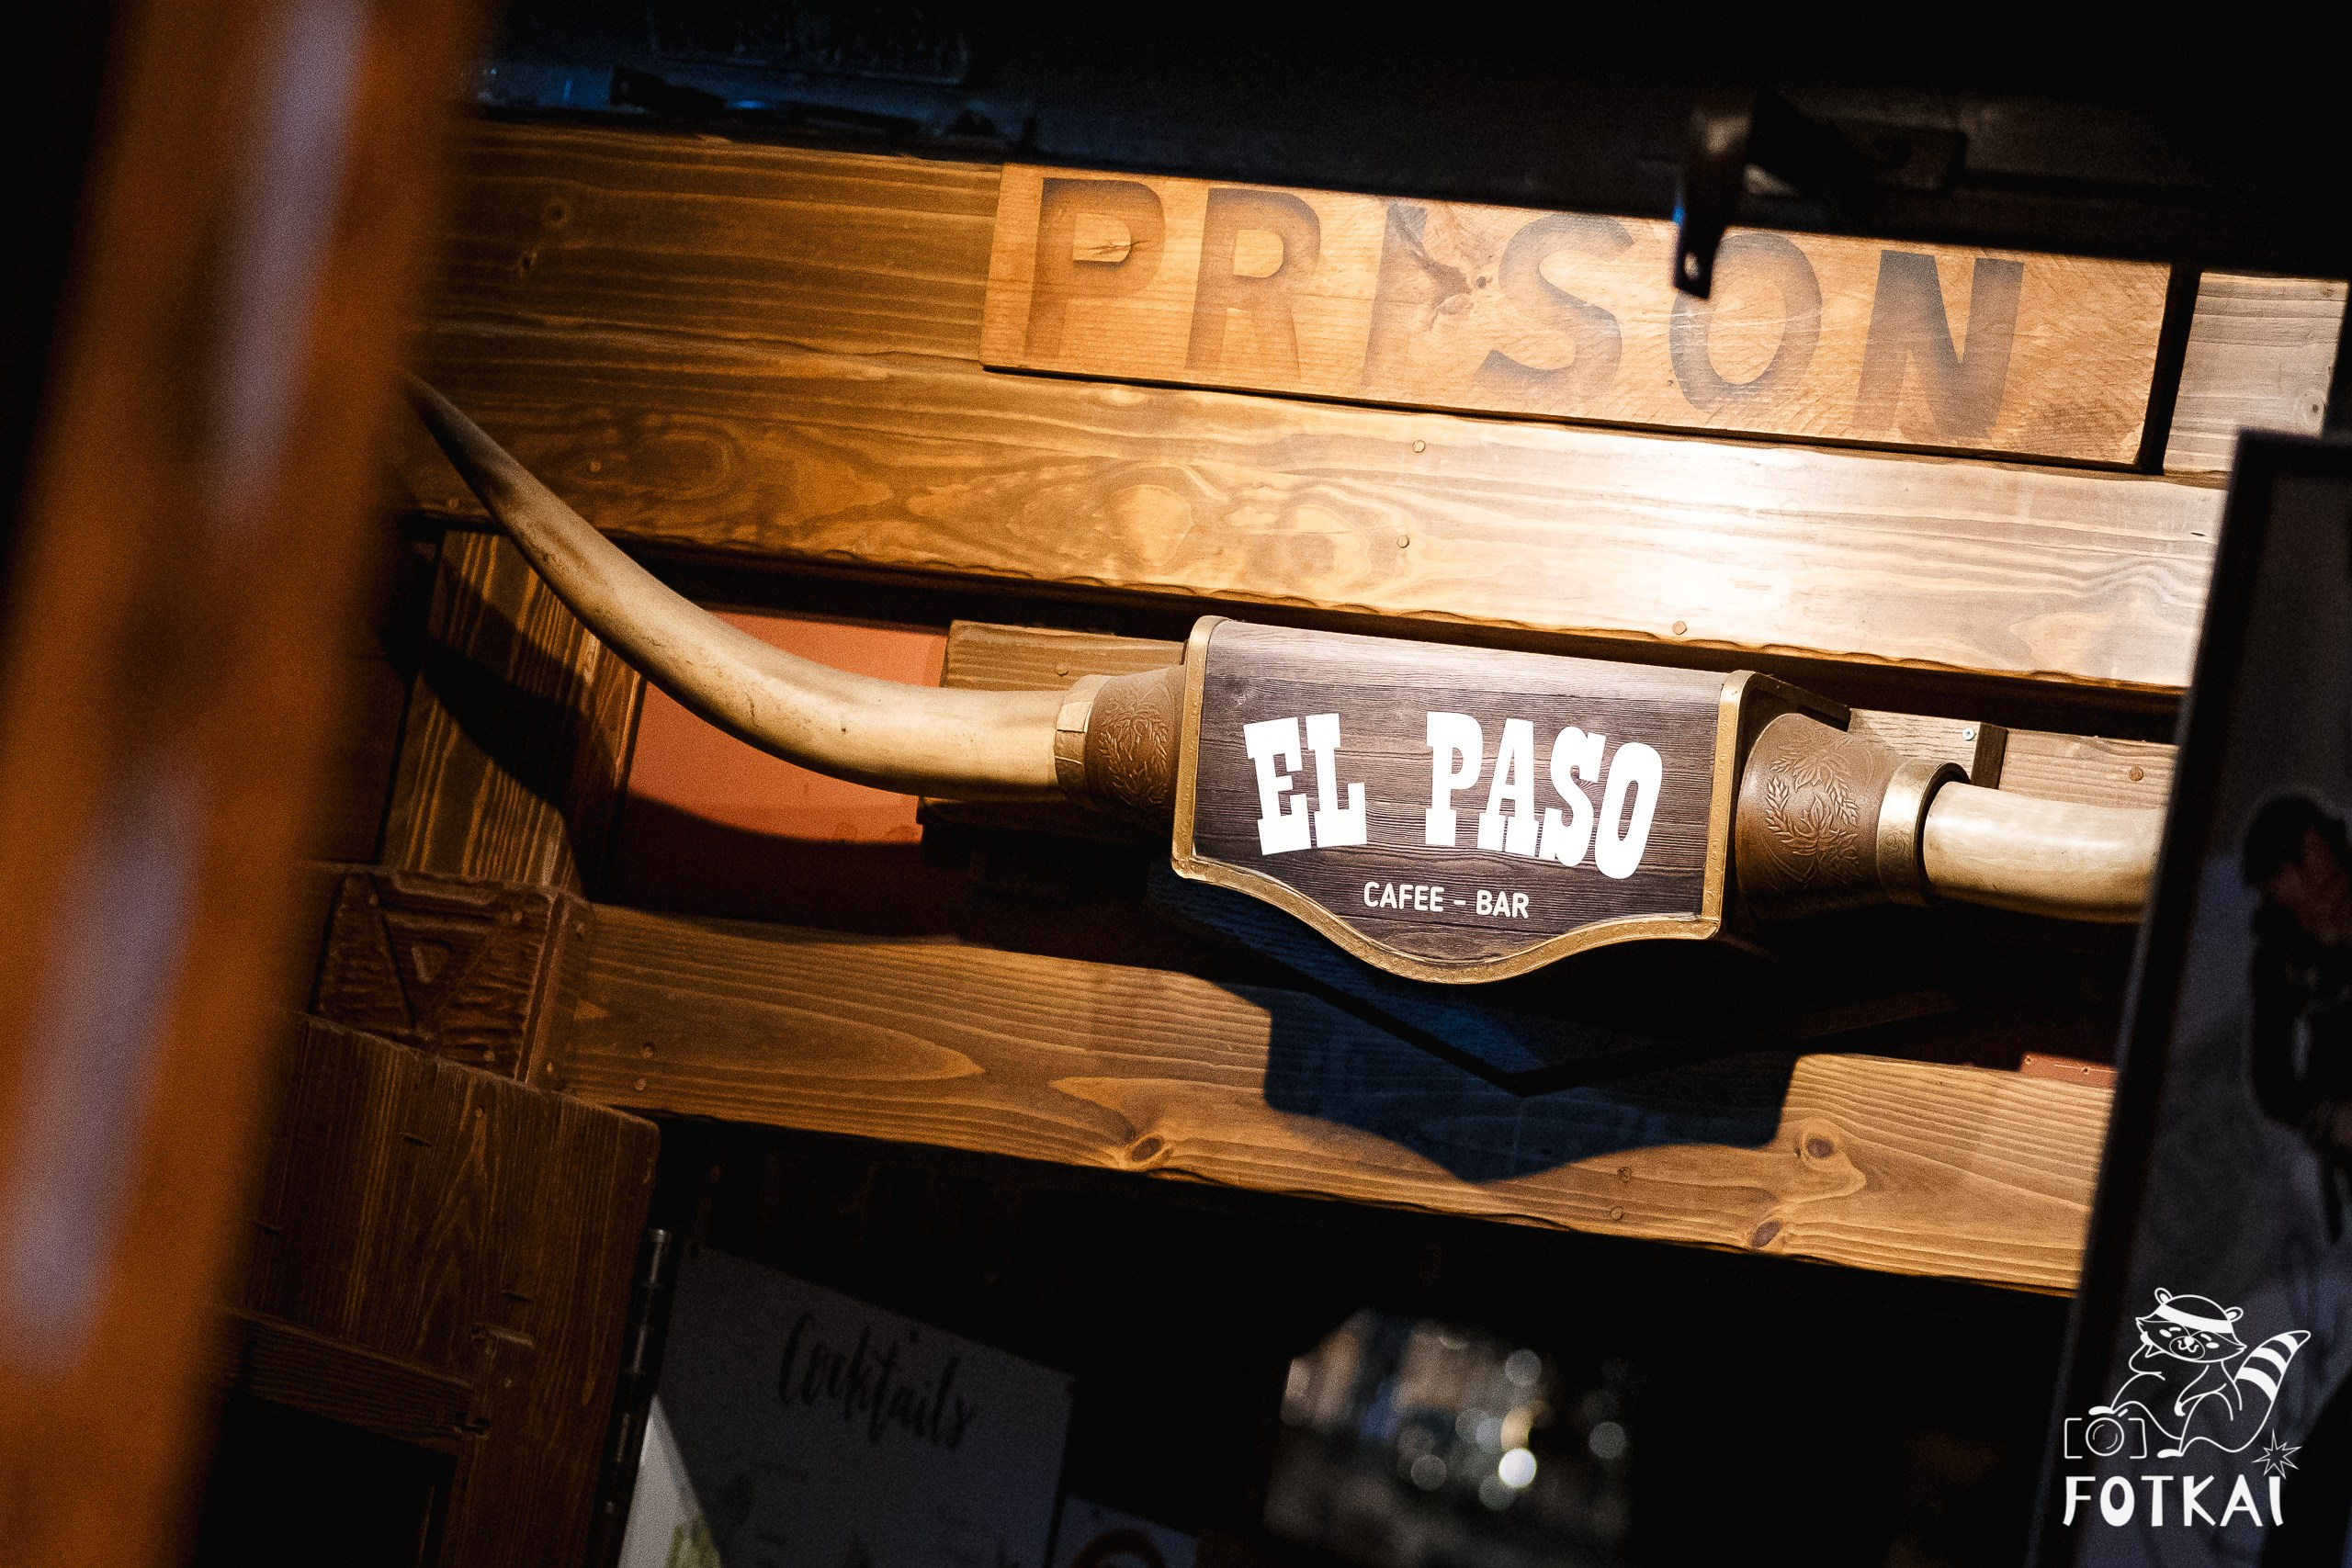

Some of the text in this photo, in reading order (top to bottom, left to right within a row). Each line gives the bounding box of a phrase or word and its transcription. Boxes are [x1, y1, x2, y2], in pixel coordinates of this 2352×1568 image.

[1021, 176, 2025, 442] PRISON
[1243, 711, 1664, 880] EL PASO
[1363, 881, 1444, 913] CAFEE
[1476, 888, 1530, 919] BAR
[778, 1312, 974, 1450] Cocktails
